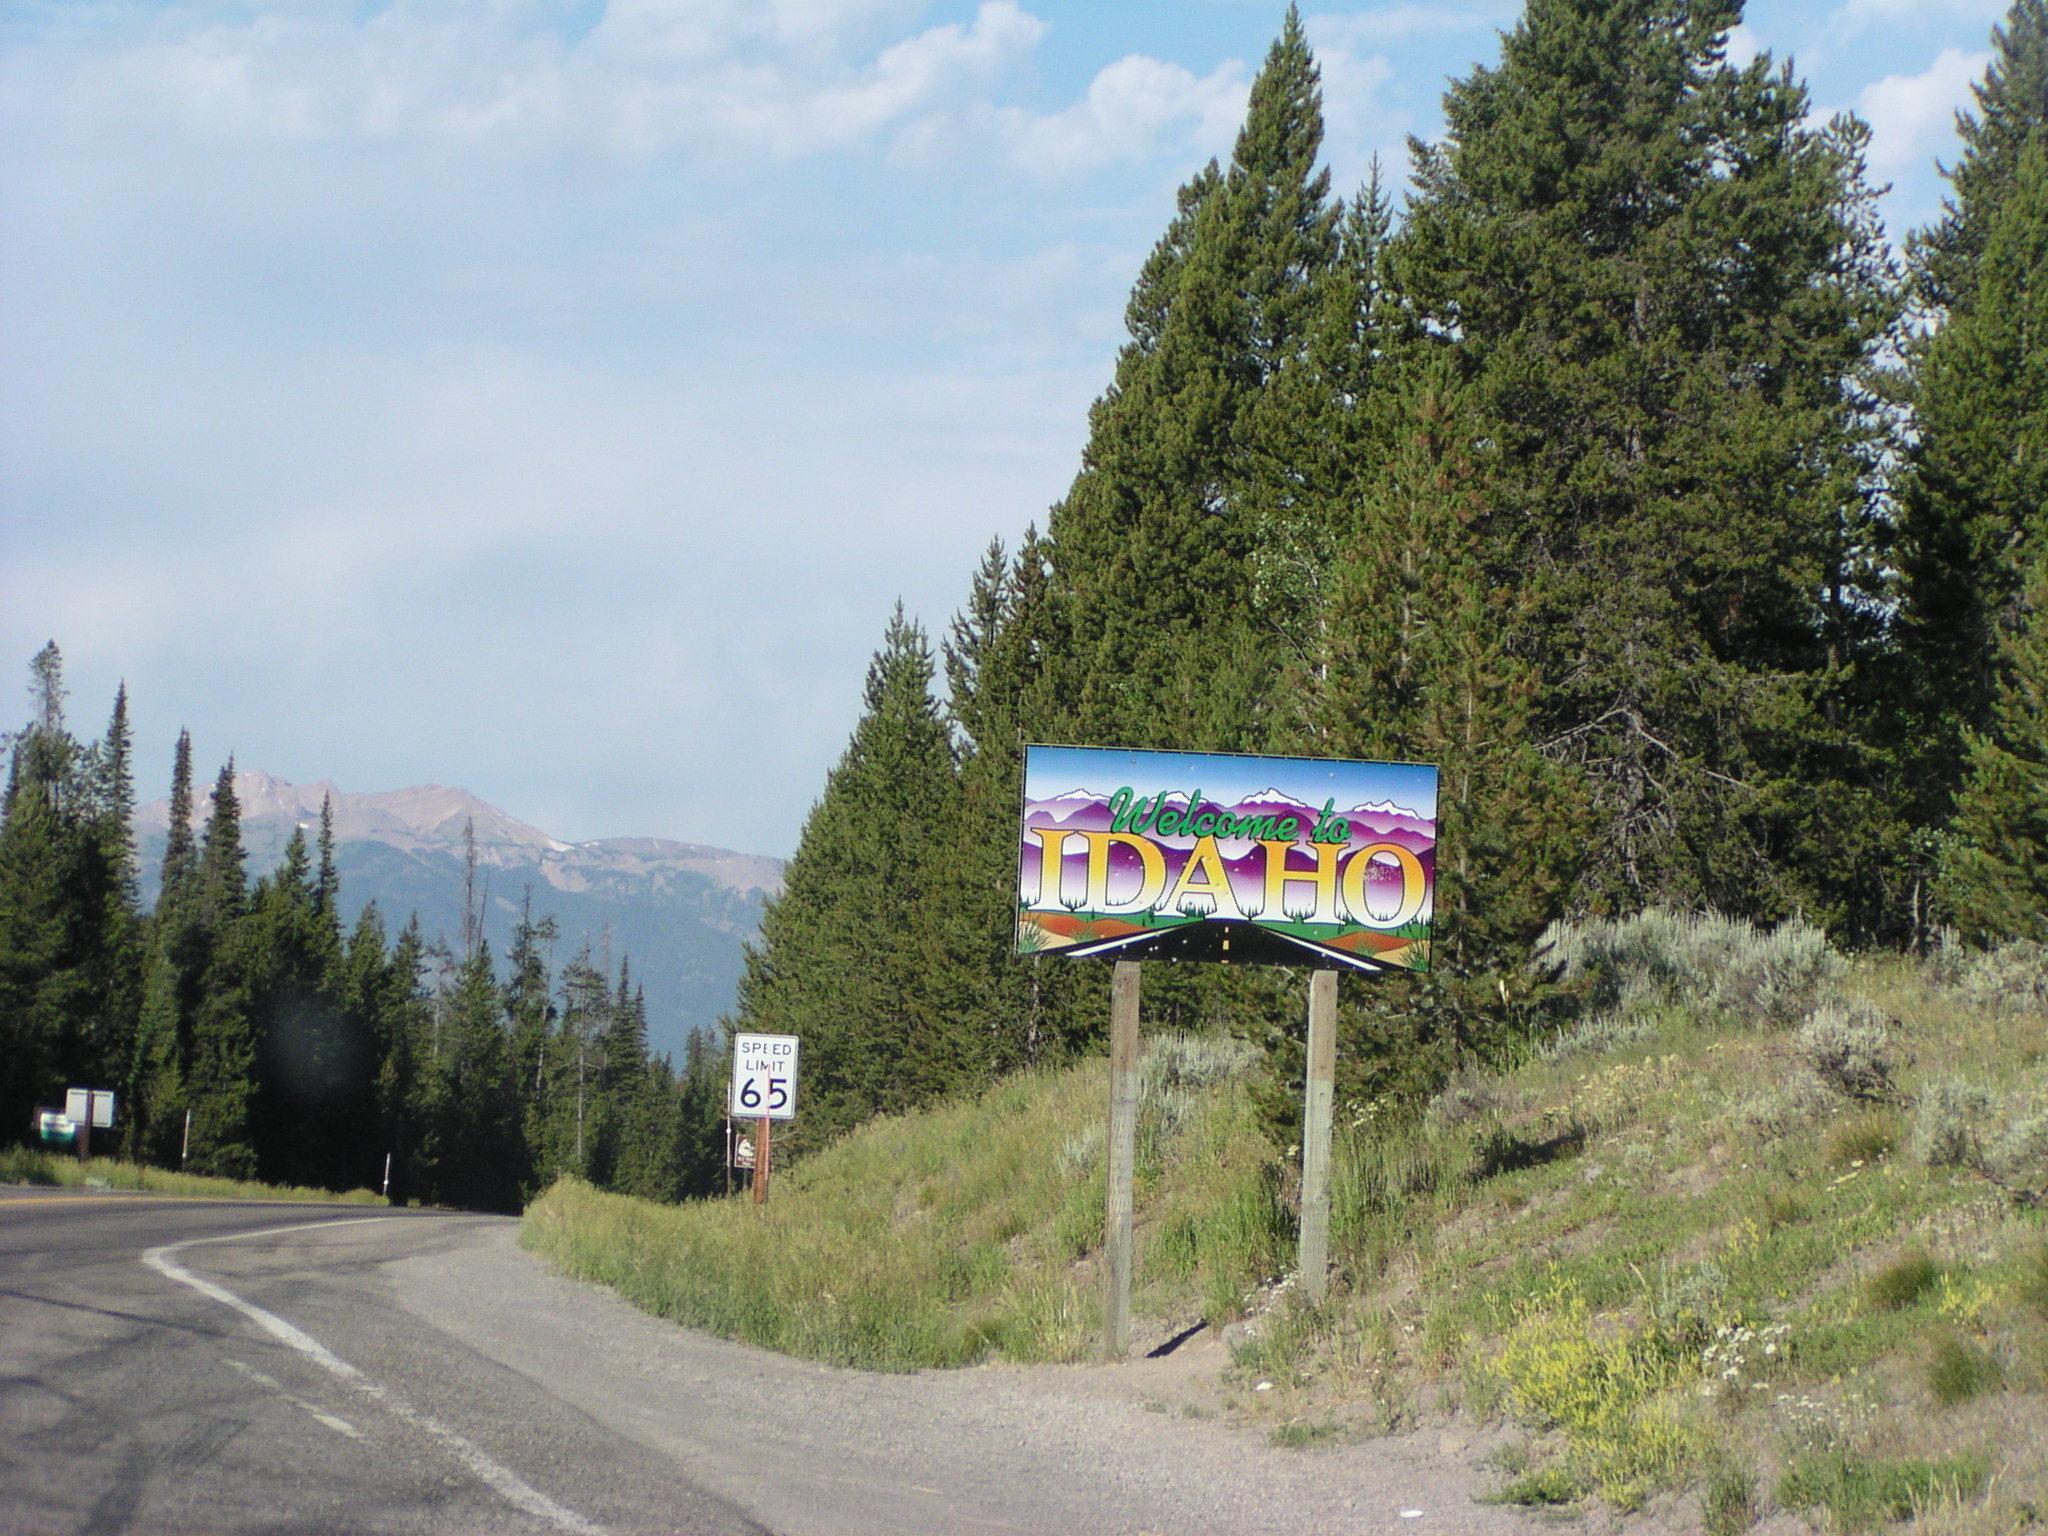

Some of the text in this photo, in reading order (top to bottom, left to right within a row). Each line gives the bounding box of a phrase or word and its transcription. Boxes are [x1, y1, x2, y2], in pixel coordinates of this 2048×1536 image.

[1108, 786, 1351, 843] Welcome to
[1027, 827, 1427, 930] IDAHO
[742, 1042, 792, 1056] SPEED
[746, 1060, 785, 1072] LIMIT
[740, 1077, 788, 1110] 65
